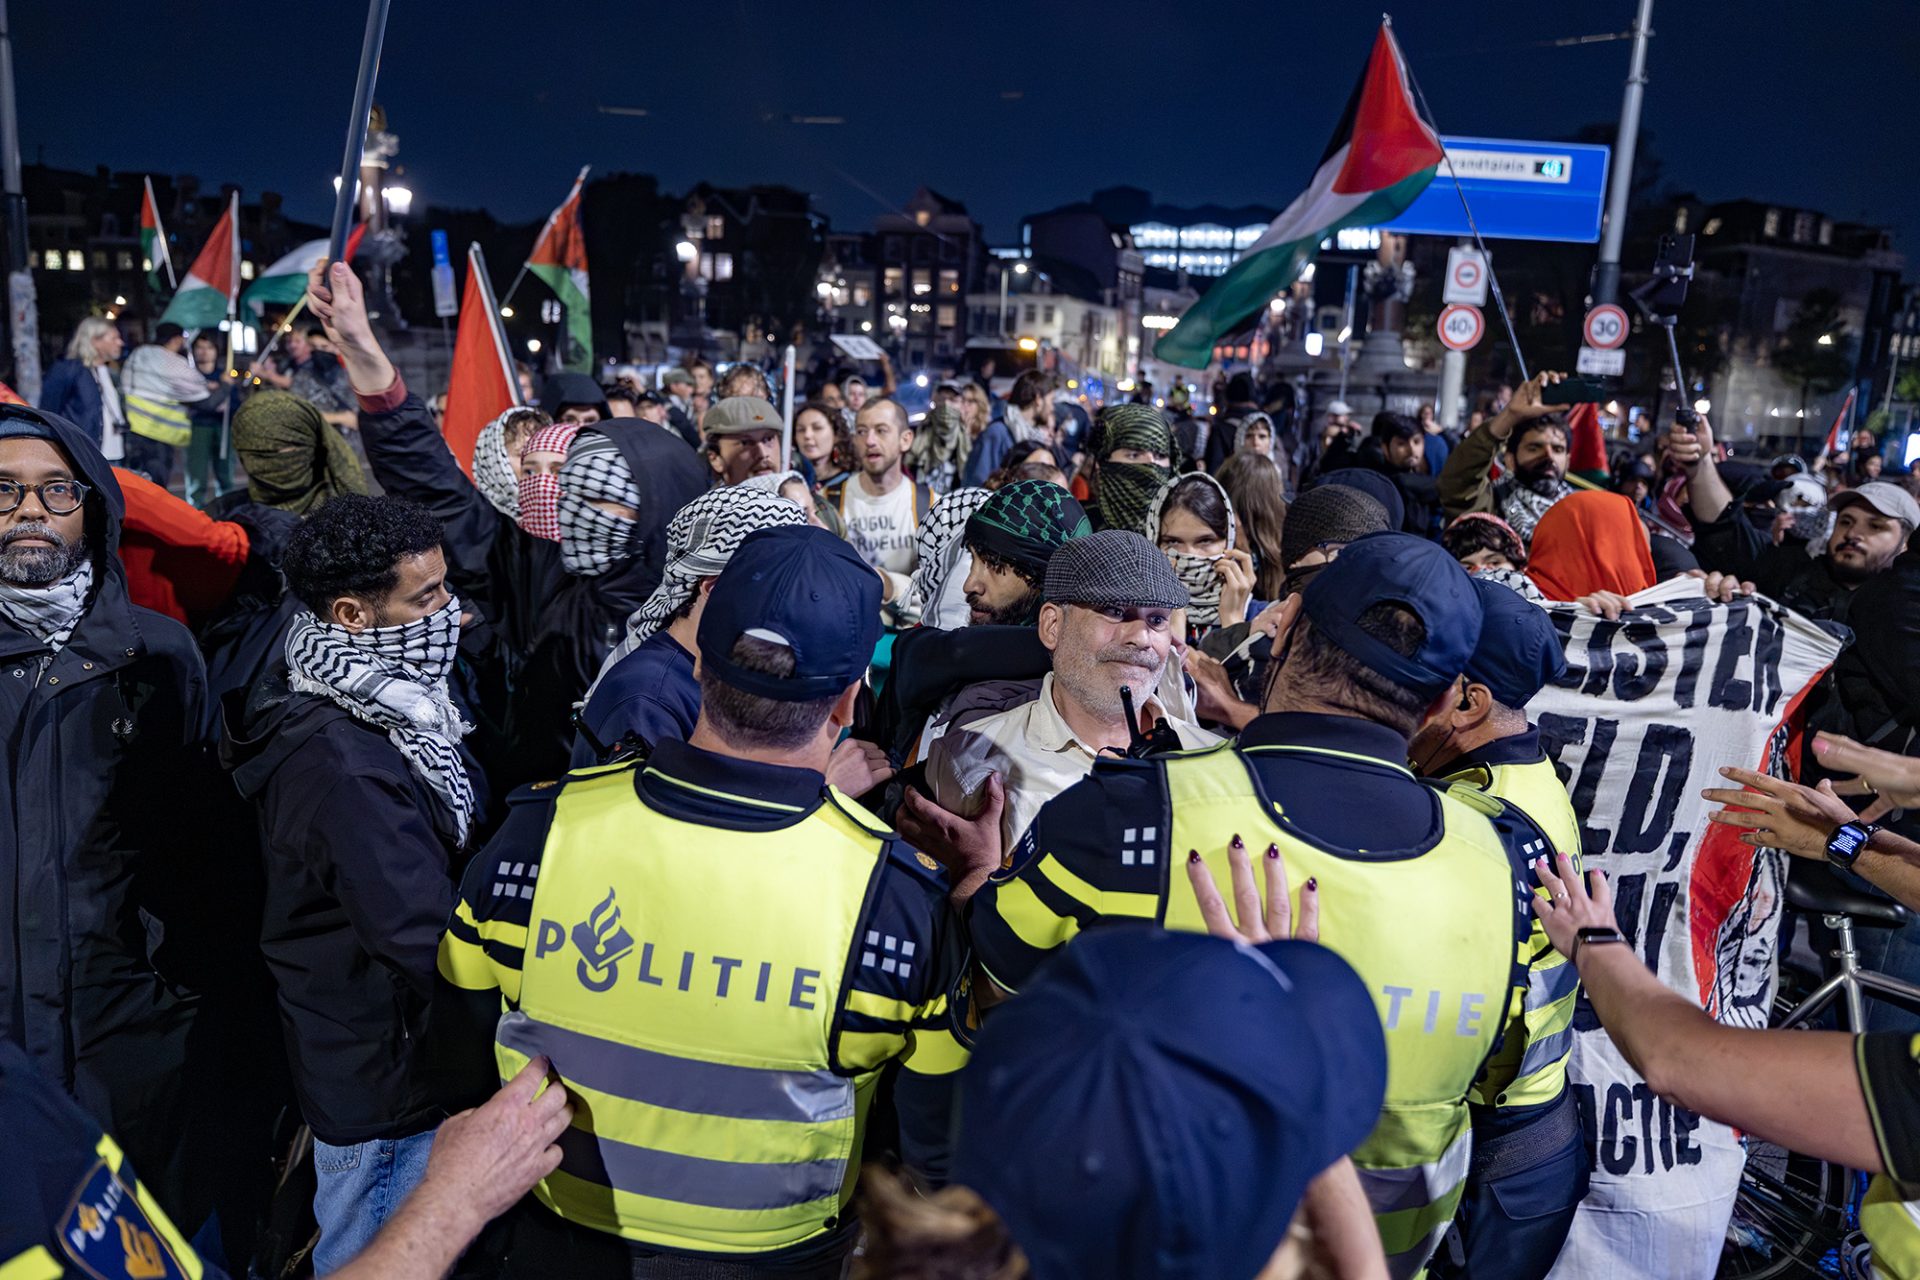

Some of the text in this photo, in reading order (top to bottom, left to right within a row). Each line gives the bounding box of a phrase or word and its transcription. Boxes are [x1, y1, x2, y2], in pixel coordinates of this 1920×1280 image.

[1444, 157, 1527, 172] randtplein
[1594, 318, 1620, 338] 30
[853, 534, 914, 552] RDELLO
[535, 912, 821, 1011] POLITIE
[1382, 984, 1486, 1037] TIE
